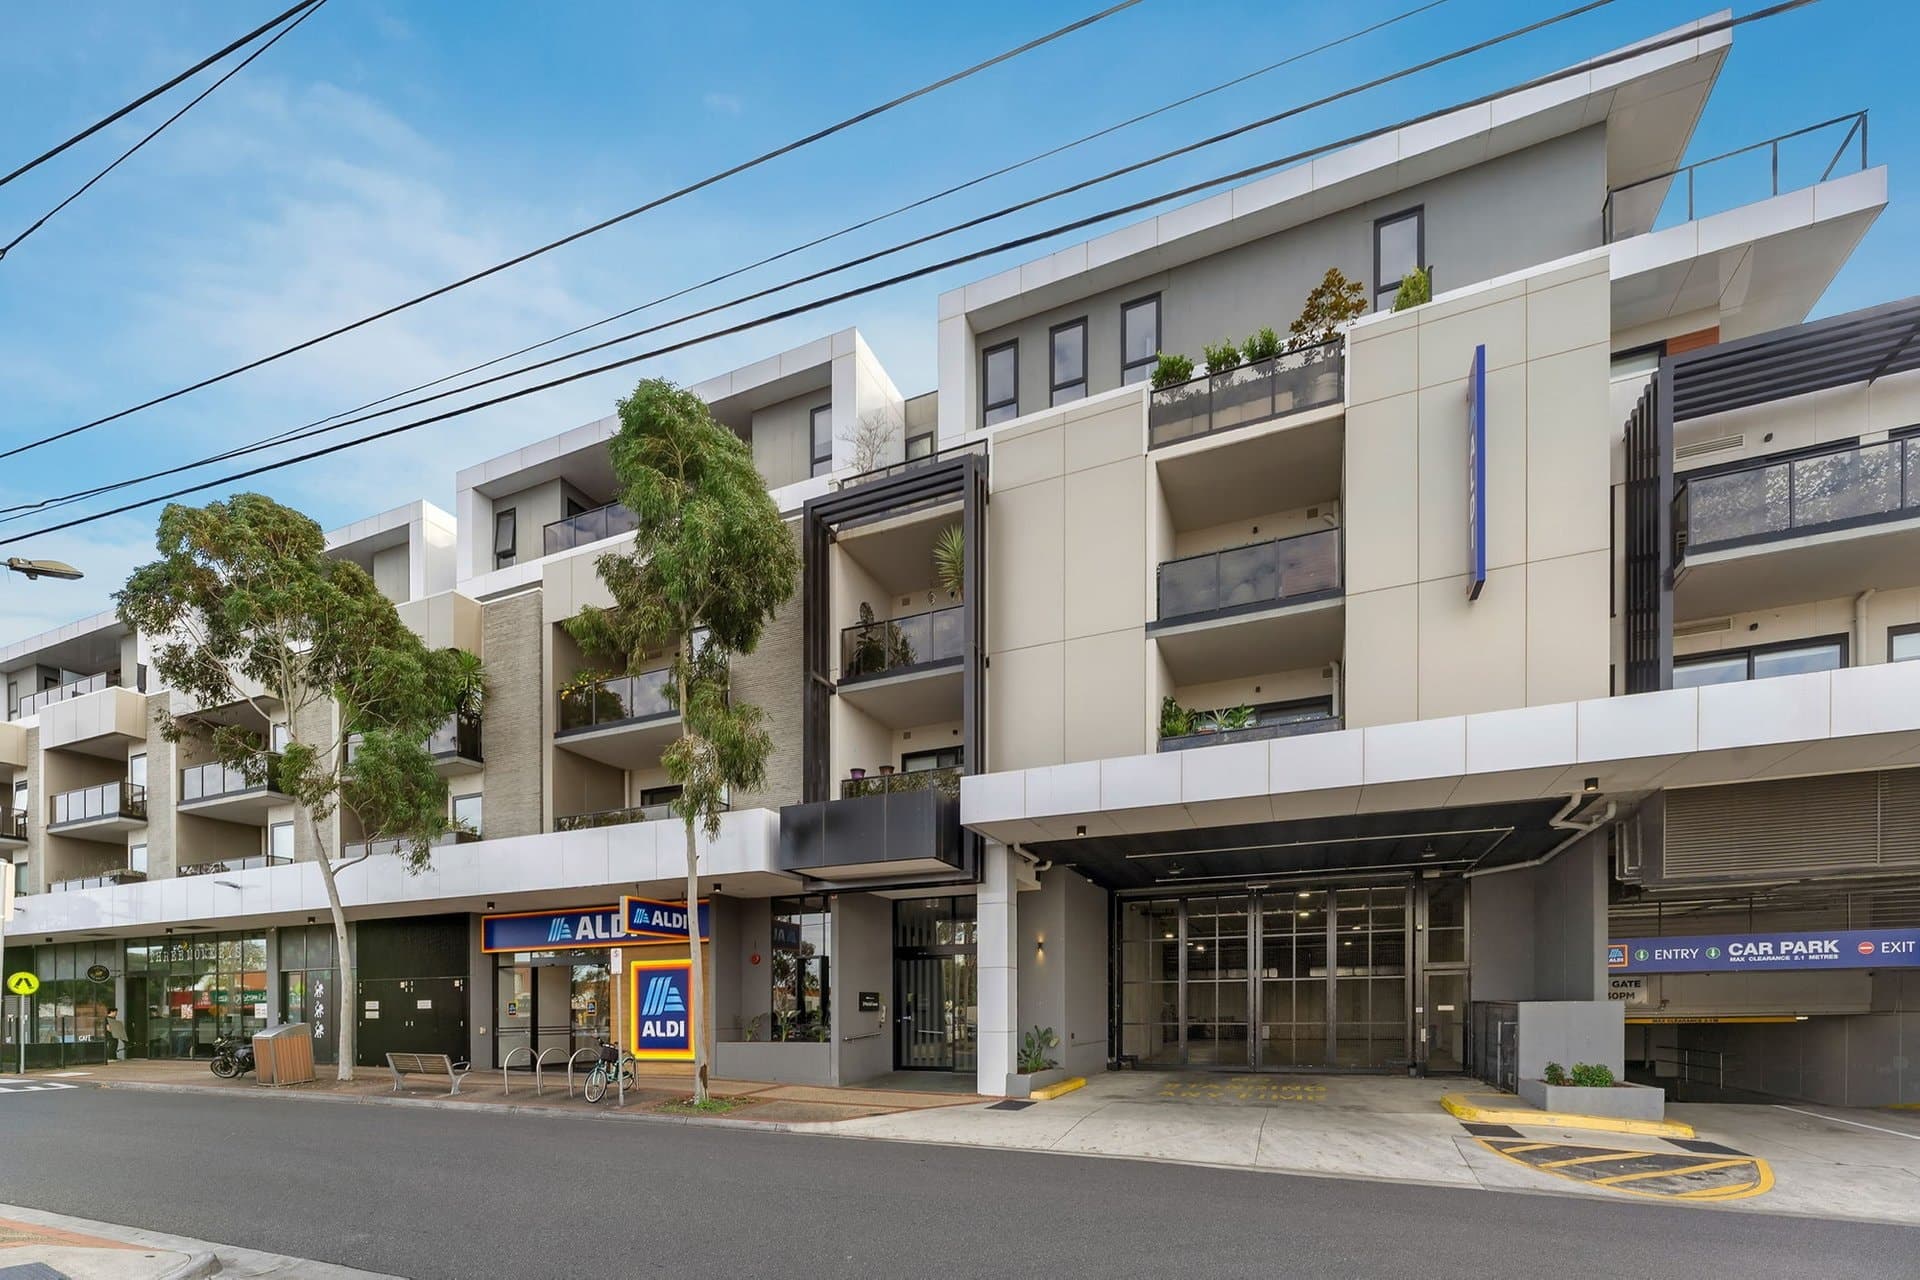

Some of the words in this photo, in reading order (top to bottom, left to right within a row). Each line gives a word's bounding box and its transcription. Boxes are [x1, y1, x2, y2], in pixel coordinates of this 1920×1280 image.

[651, 910, 688, 929] ALDI
[1728, 942, 1774, 956] CAR
[1780, 939, 1840, 954] PARK
[1881, 941, 1916, 953] EXIT
[1654, 948, 1700, 960] ENTRY
[1809, 952, 1838, 960] METRES
[1612, 980, 1641, 988] GATE
[642, 1020, 685, 1037] ALDI
